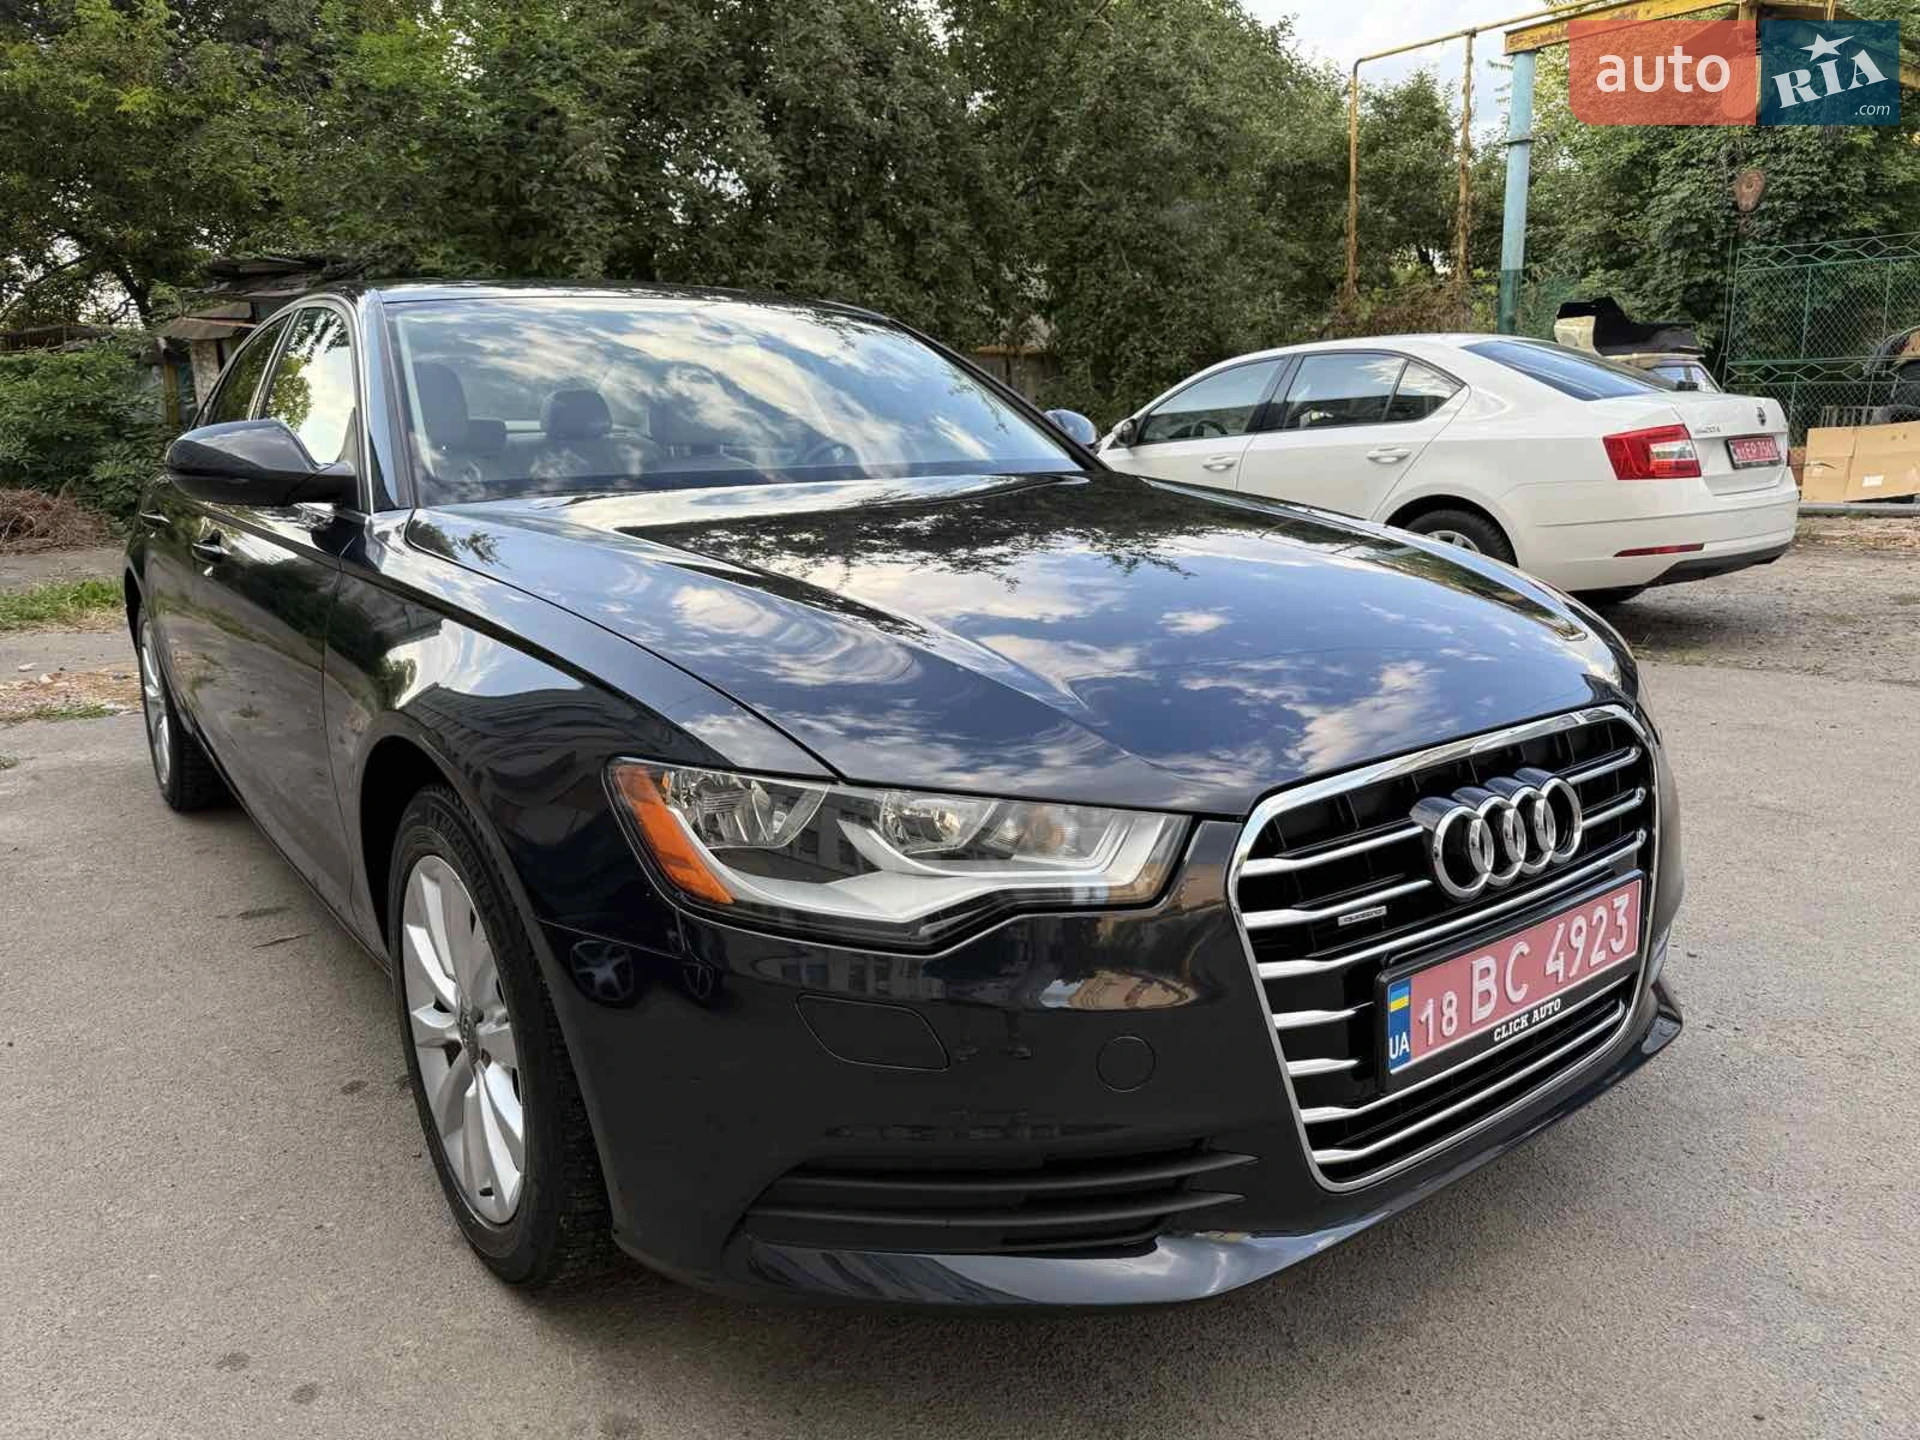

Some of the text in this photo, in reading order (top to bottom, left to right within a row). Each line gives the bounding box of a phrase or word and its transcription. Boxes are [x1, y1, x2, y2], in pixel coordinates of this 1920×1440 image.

[1420, 893, 1629, 1047] 18 BC 4923
[1493, 998, 1562, 1043] CLICK AUTO
[1388, 1031, 1410, 1060] UA
